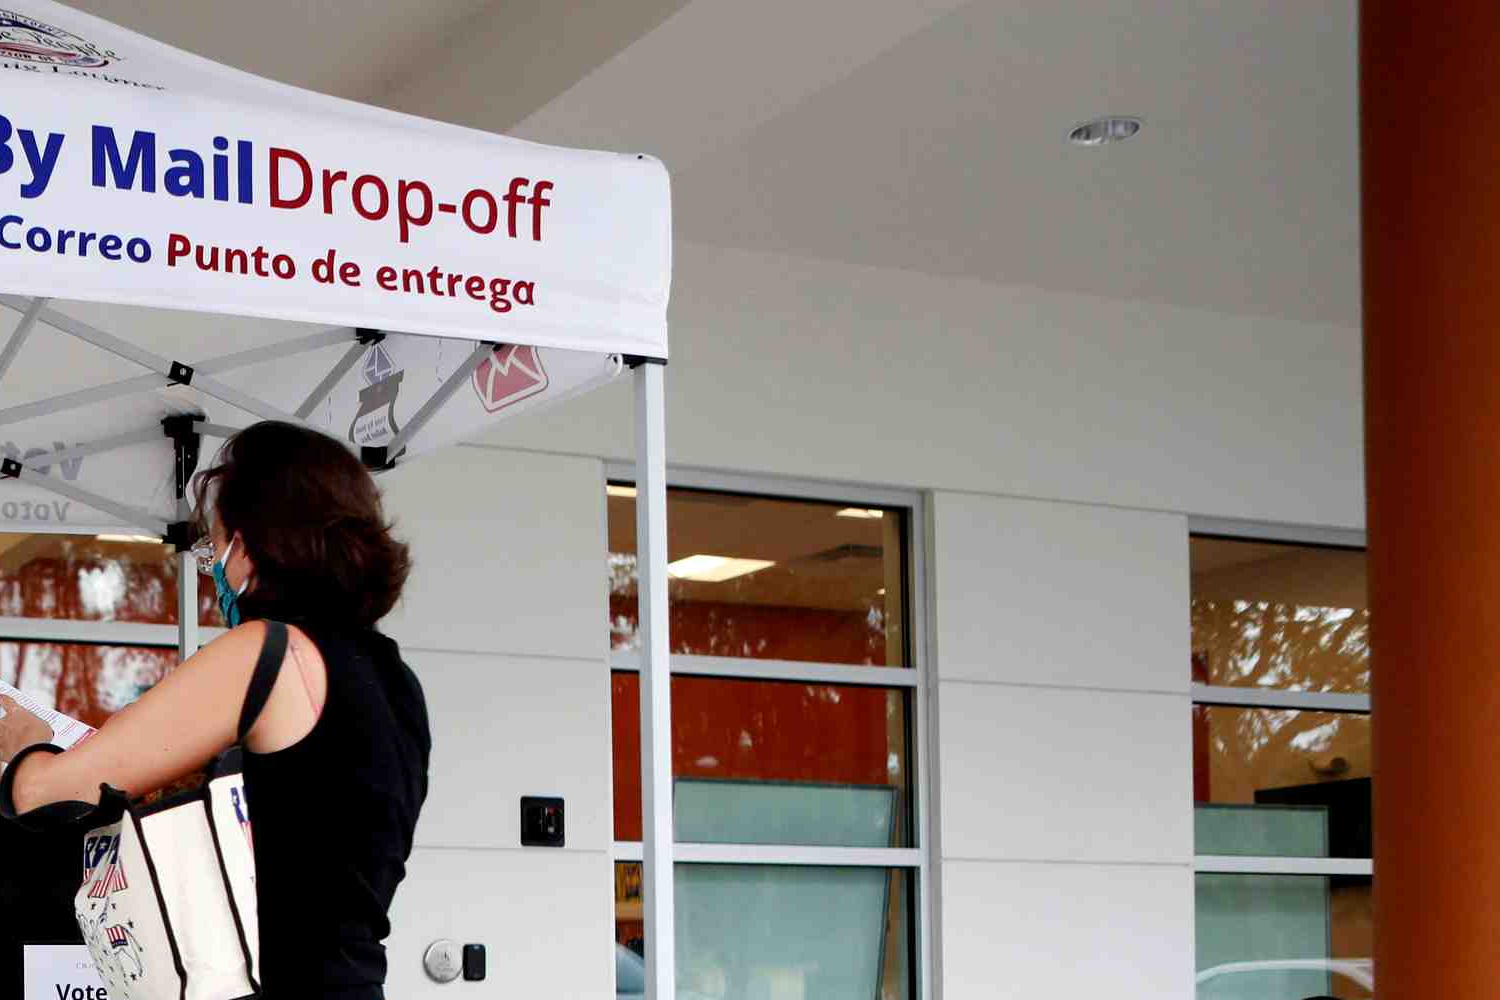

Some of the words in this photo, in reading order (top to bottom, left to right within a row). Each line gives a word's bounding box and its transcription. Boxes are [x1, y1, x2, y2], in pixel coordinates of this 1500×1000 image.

[91, 124, 254, 204] Mail
[269, 148, 553, 242] Drop-off
[167, 233, 296, 280] Punto
[312, 250, 360, 284] de
[376, 265, 536, 313] entrega
